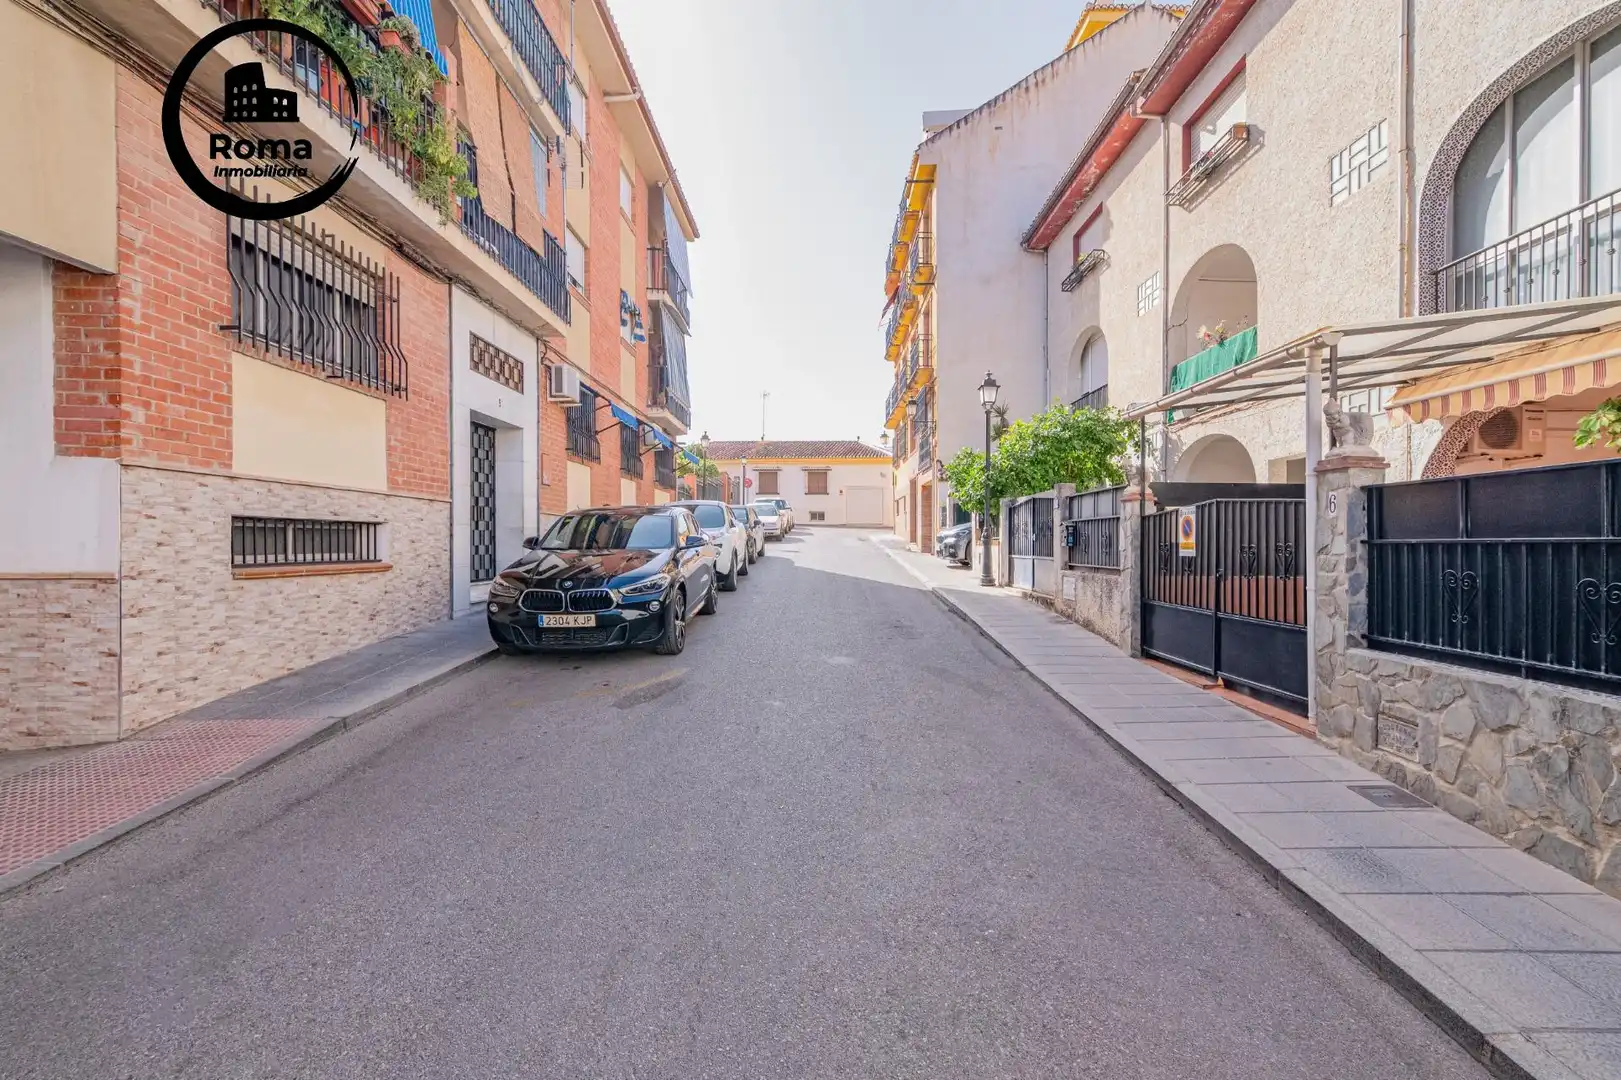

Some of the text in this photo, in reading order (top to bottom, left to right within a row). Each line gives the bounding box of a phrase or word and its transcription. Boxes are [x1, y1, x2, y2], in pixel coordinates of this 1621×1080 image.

[1329, 494, 1337, 513] 6
[545, 615, 592, 626] 2304 KJP
